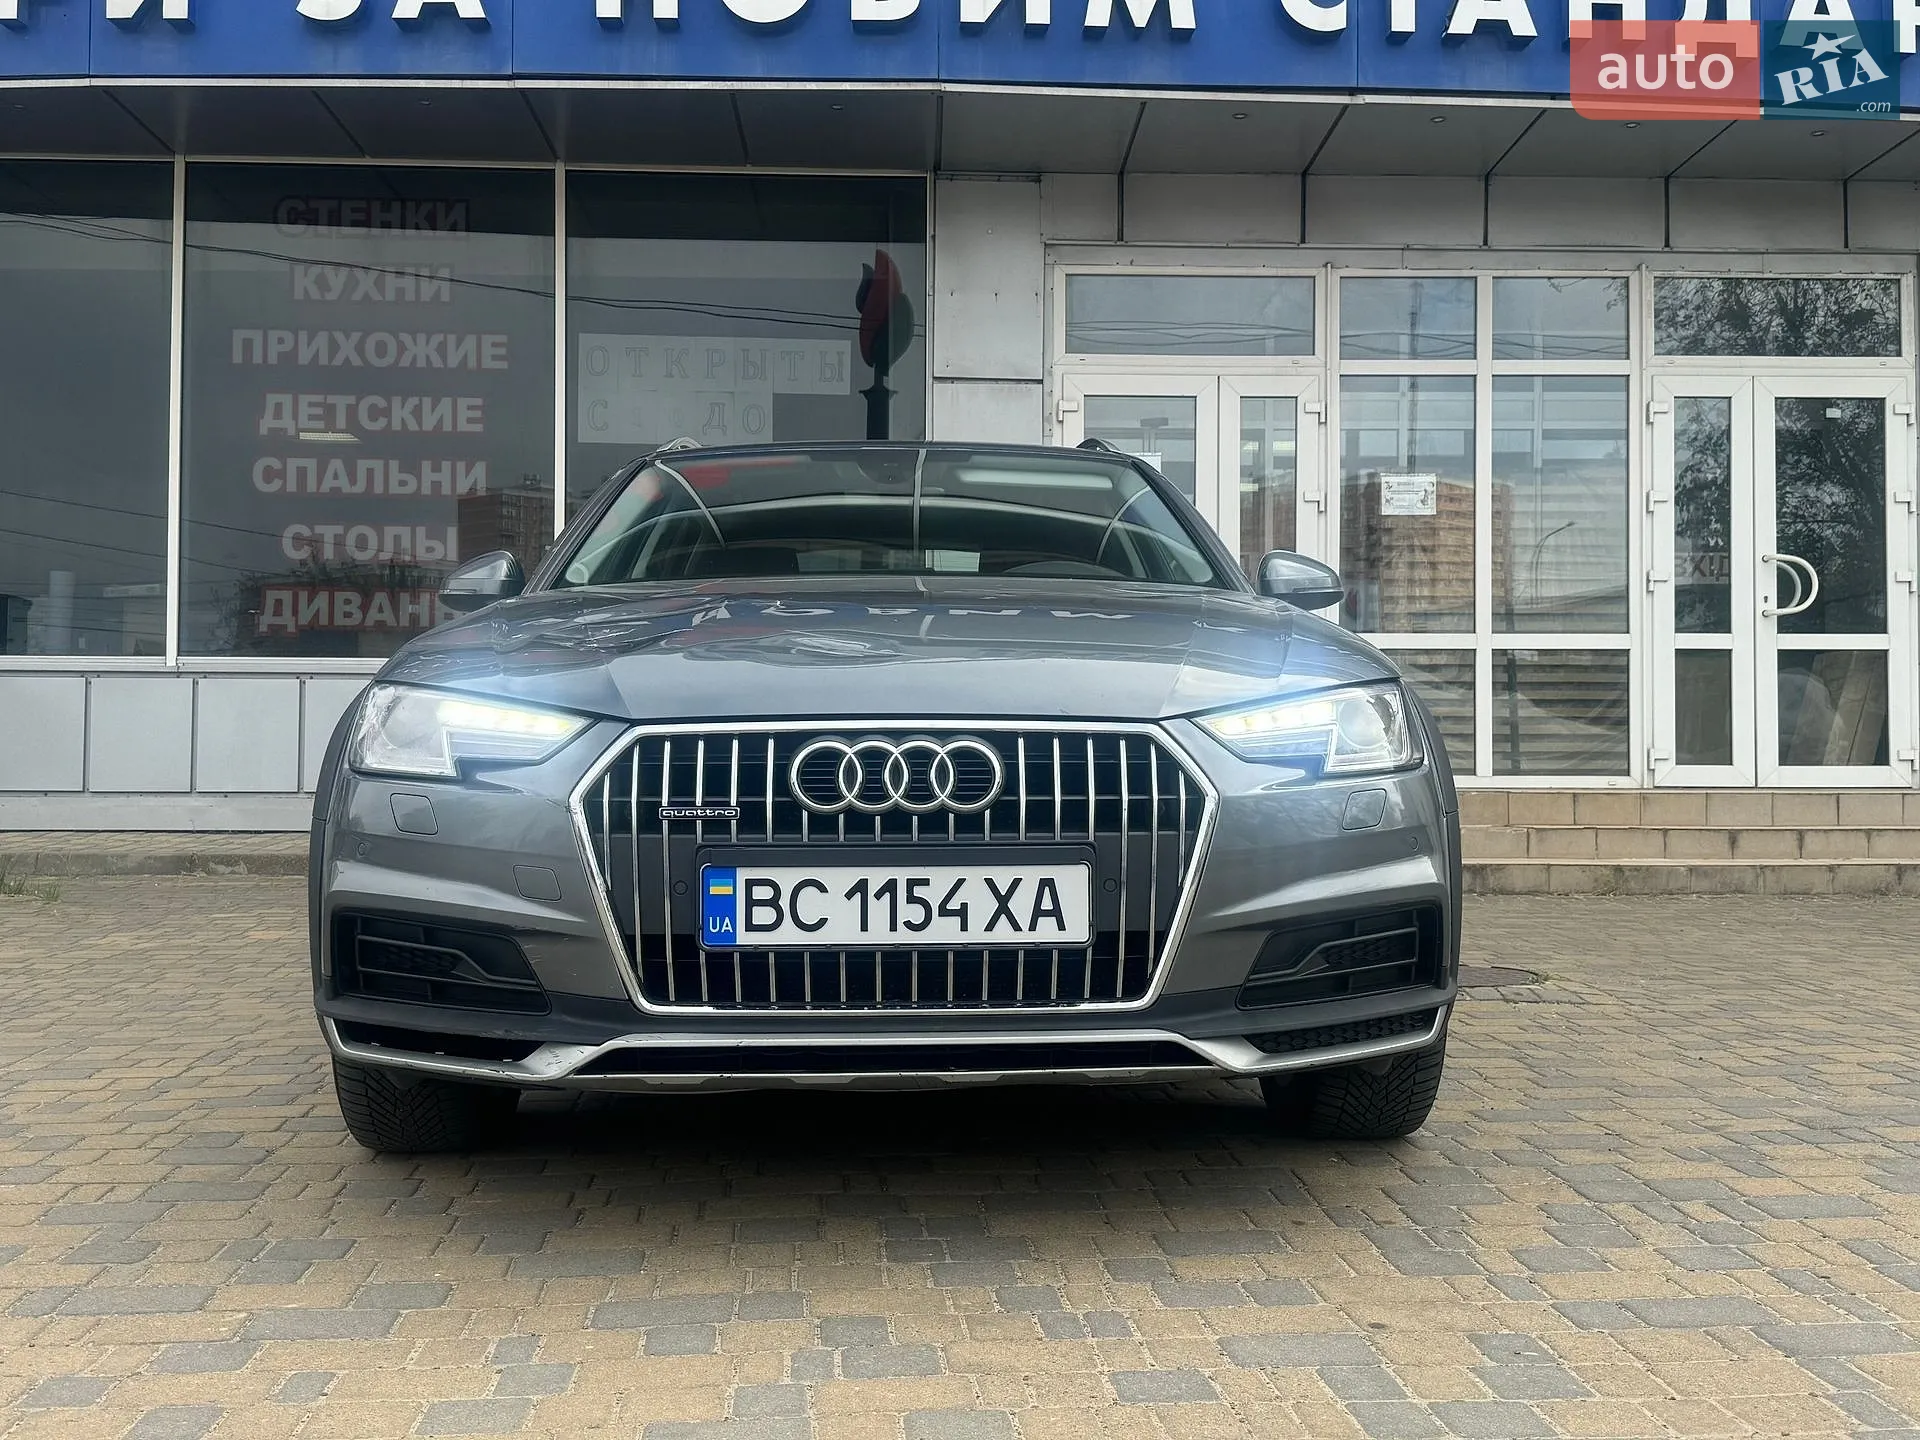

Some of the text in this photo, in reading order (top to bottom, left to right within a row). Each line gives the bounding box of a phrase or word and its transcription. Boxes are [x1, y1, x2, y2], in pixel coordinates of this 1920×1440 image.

[276, 199, 468, 238] СТЕНКИ
[292, 264, 451, 302] КУХНИ
[231, 328, 509, 369] ПРИХОЖИЕ
[585, 346, 845, 383] ОТКРЫТЫ
[259, 393, 484, 436] ДЕТСКИЕ
[587, 400, 609, 432] С
[702, 402, 766, 436] ДО
[252, 457, 487, 496] СПАЛЬНИ
[281, 524, 458, 562] СТОЛЫ
[662, 809, 736, 818] quattro
[743, 877, 1067, 933] BC 1154 XA
[709, 916, 733, 933] UA
